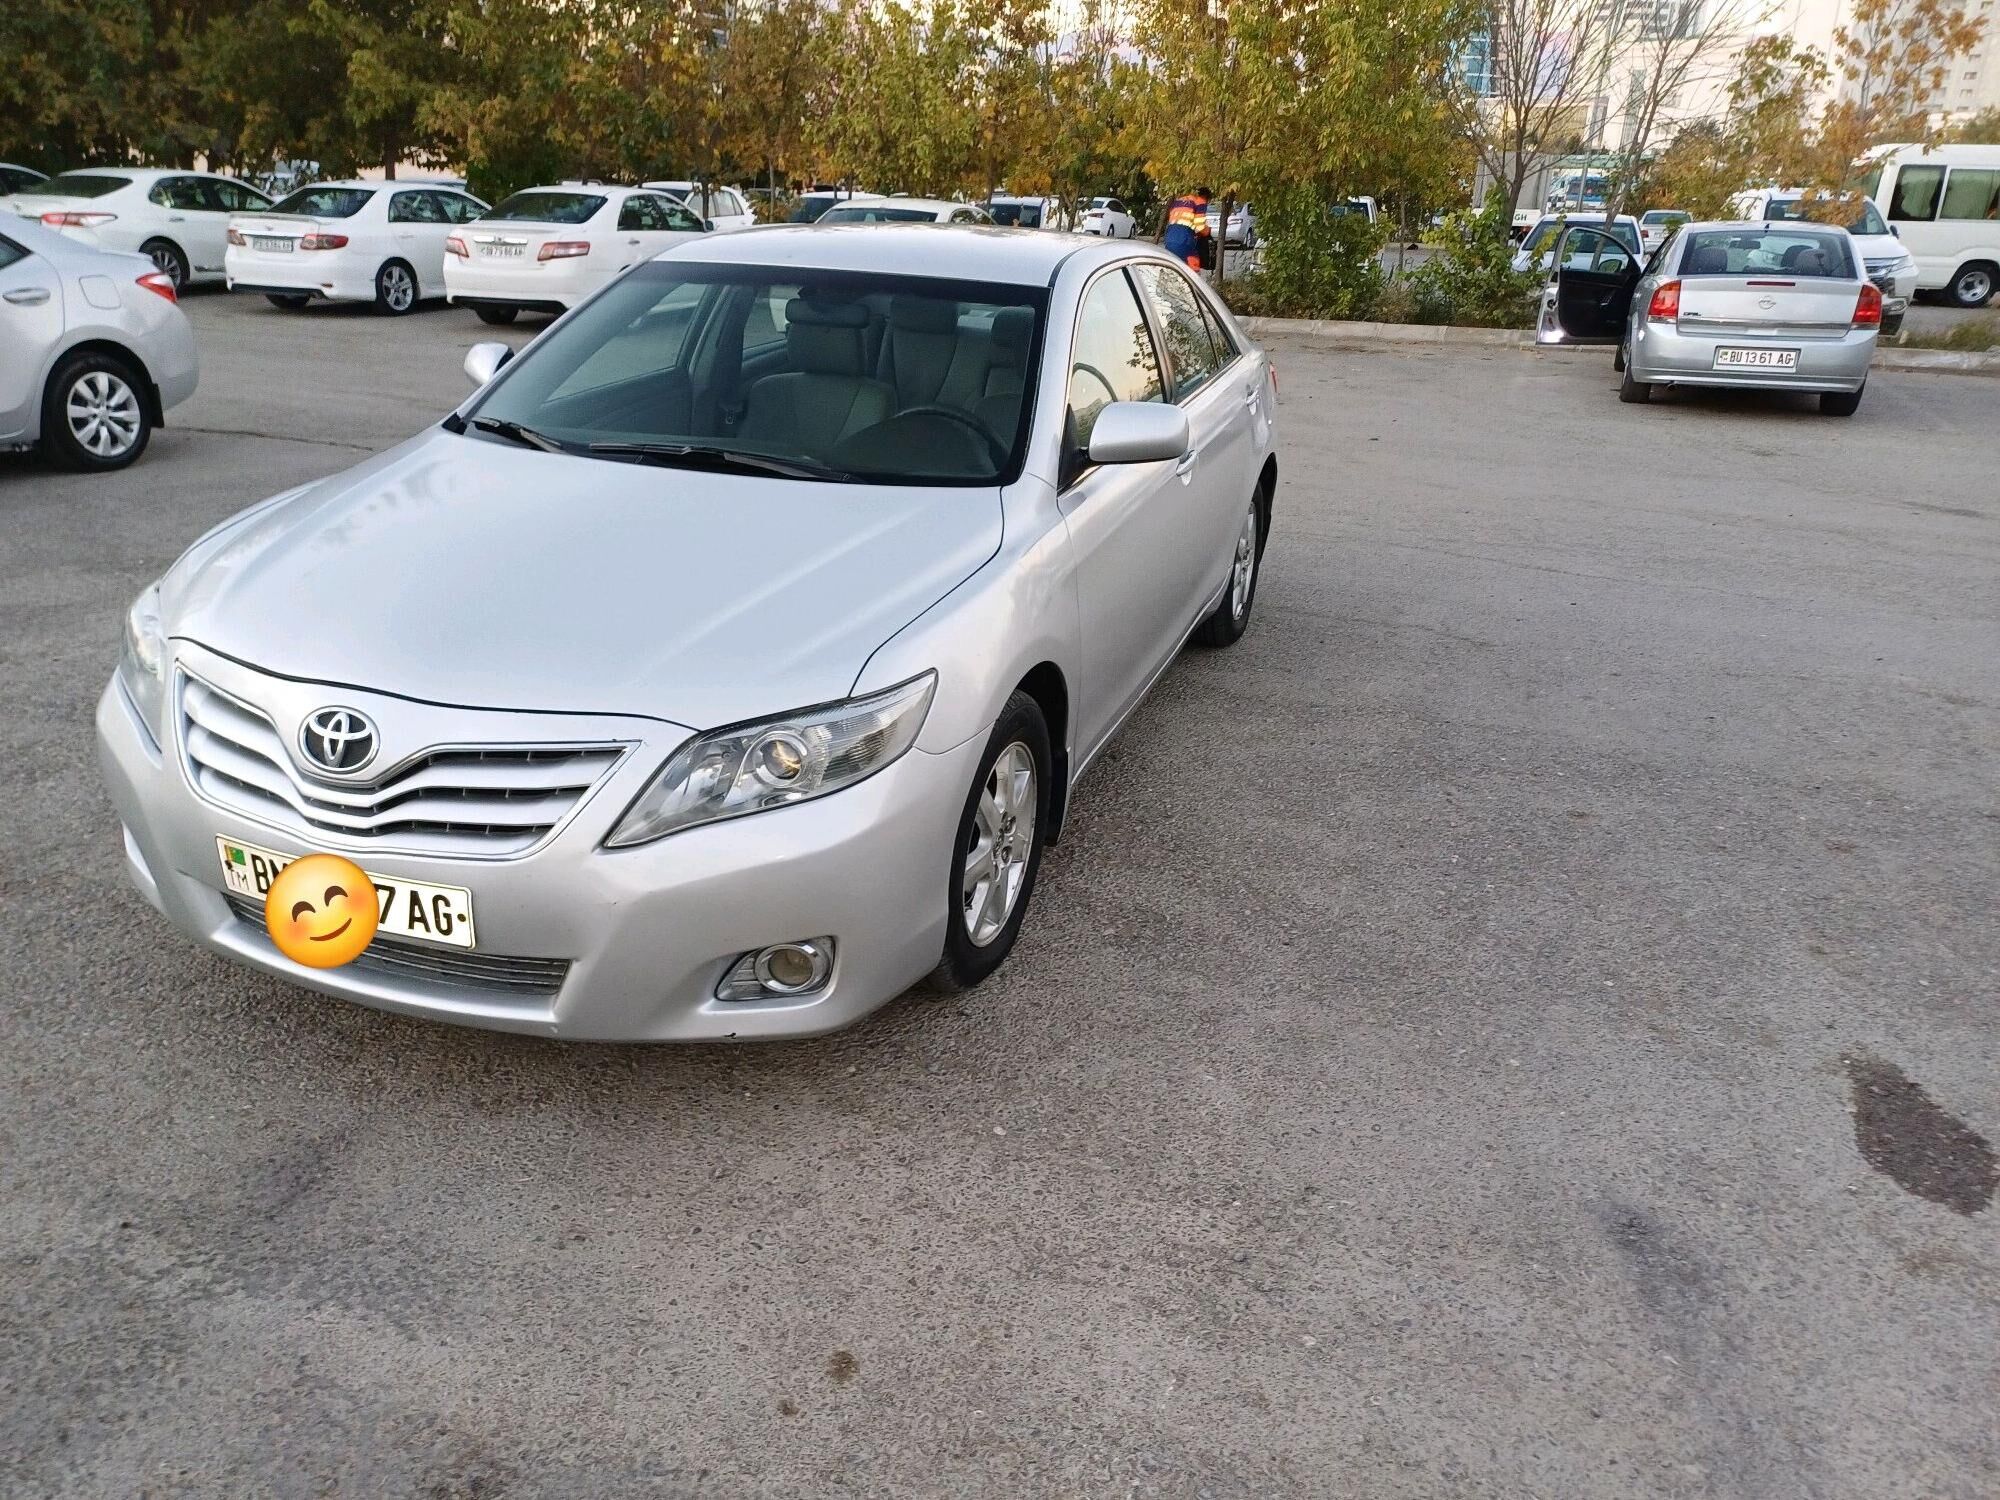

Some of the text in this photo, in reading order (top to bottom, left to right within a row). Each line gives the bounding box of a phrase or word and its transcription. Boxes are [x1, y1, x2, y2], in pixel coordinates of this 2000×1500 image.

[1729, 351, 1744, 363] BU
[1776, 353, 1793, 365] AG
[373, 882, 396, 925] 7
[407, 889, 454, 937] AG
